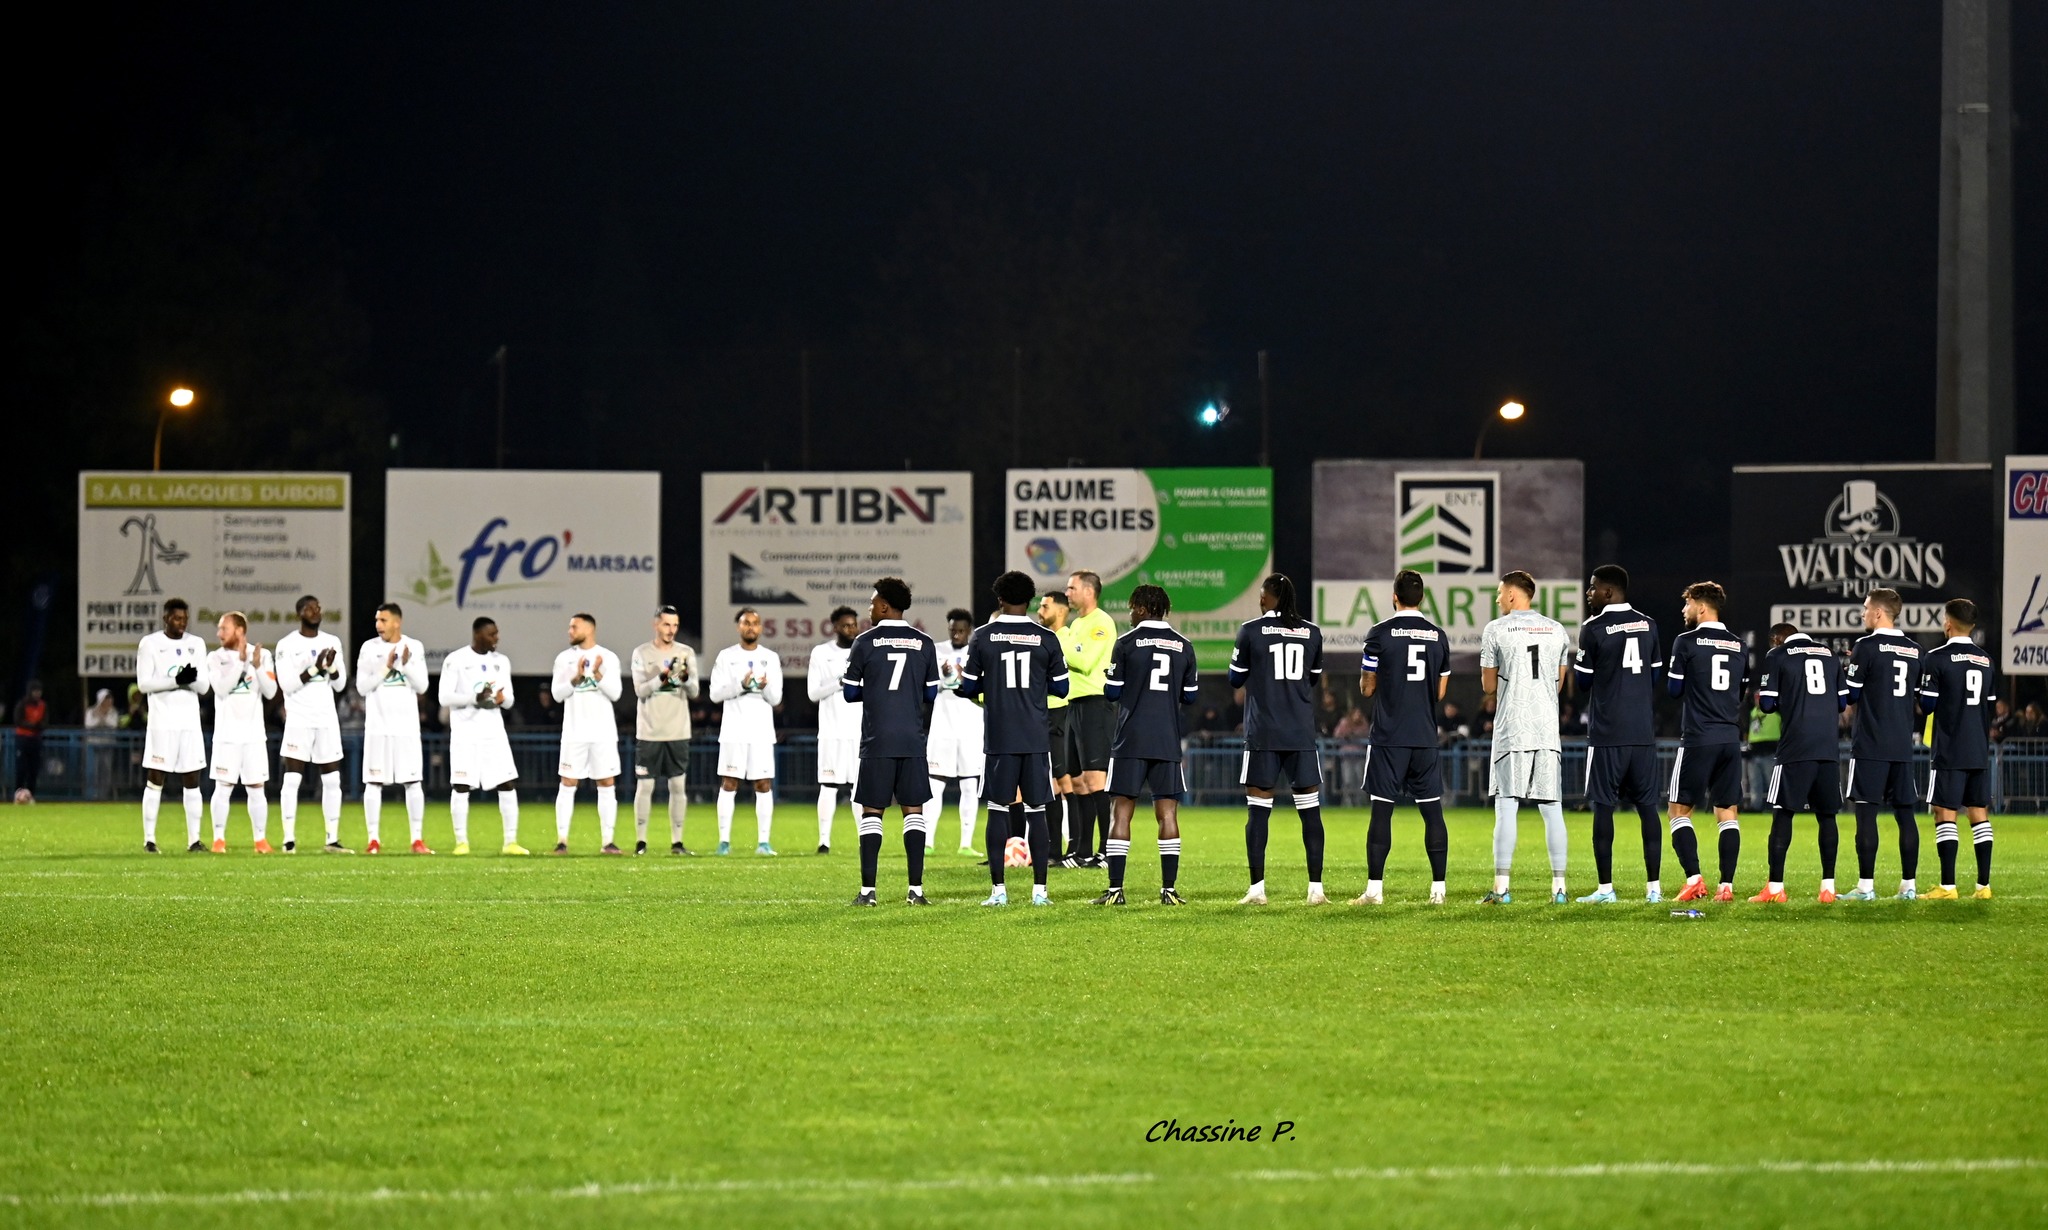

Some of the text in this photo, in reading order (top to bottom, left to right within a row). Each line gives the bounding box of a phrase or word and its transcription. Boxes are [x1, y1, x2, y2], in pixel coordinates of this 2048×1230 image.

[163, 483, 252, 500] JACQUES
[260, 483, 338, 500] DUBOIS
[713, 487, 945, 524] ARTIBAT
[1014, 479, 1115, 501] GAUME
[1013, 509, 1155, 531] ENERGIES
[567, 555, 654, 572] MARSAC
[1777, 542, 1946, 589] WATSONS
[786, 619, 814, 637] 53
[1782, 608, 1941, 627] PERIGUX
[887, 652, 907, 691] 7
[1000, 651, 1031, 688] 11
[1150, 653, 1171, 691] 2
[1269, 642, 1304, 681] 10
[1407, 644, 1426, 681] 5
[1527, 644, 1540, 679] 1
[1622, 637, 1643, 674] 4
[1711, 654, 1731, 691] 6
[1804, 659, 1826, 695] 8
[1892, 660, 1908, 697] 3
[1966, 669, 1983, 706] 9
